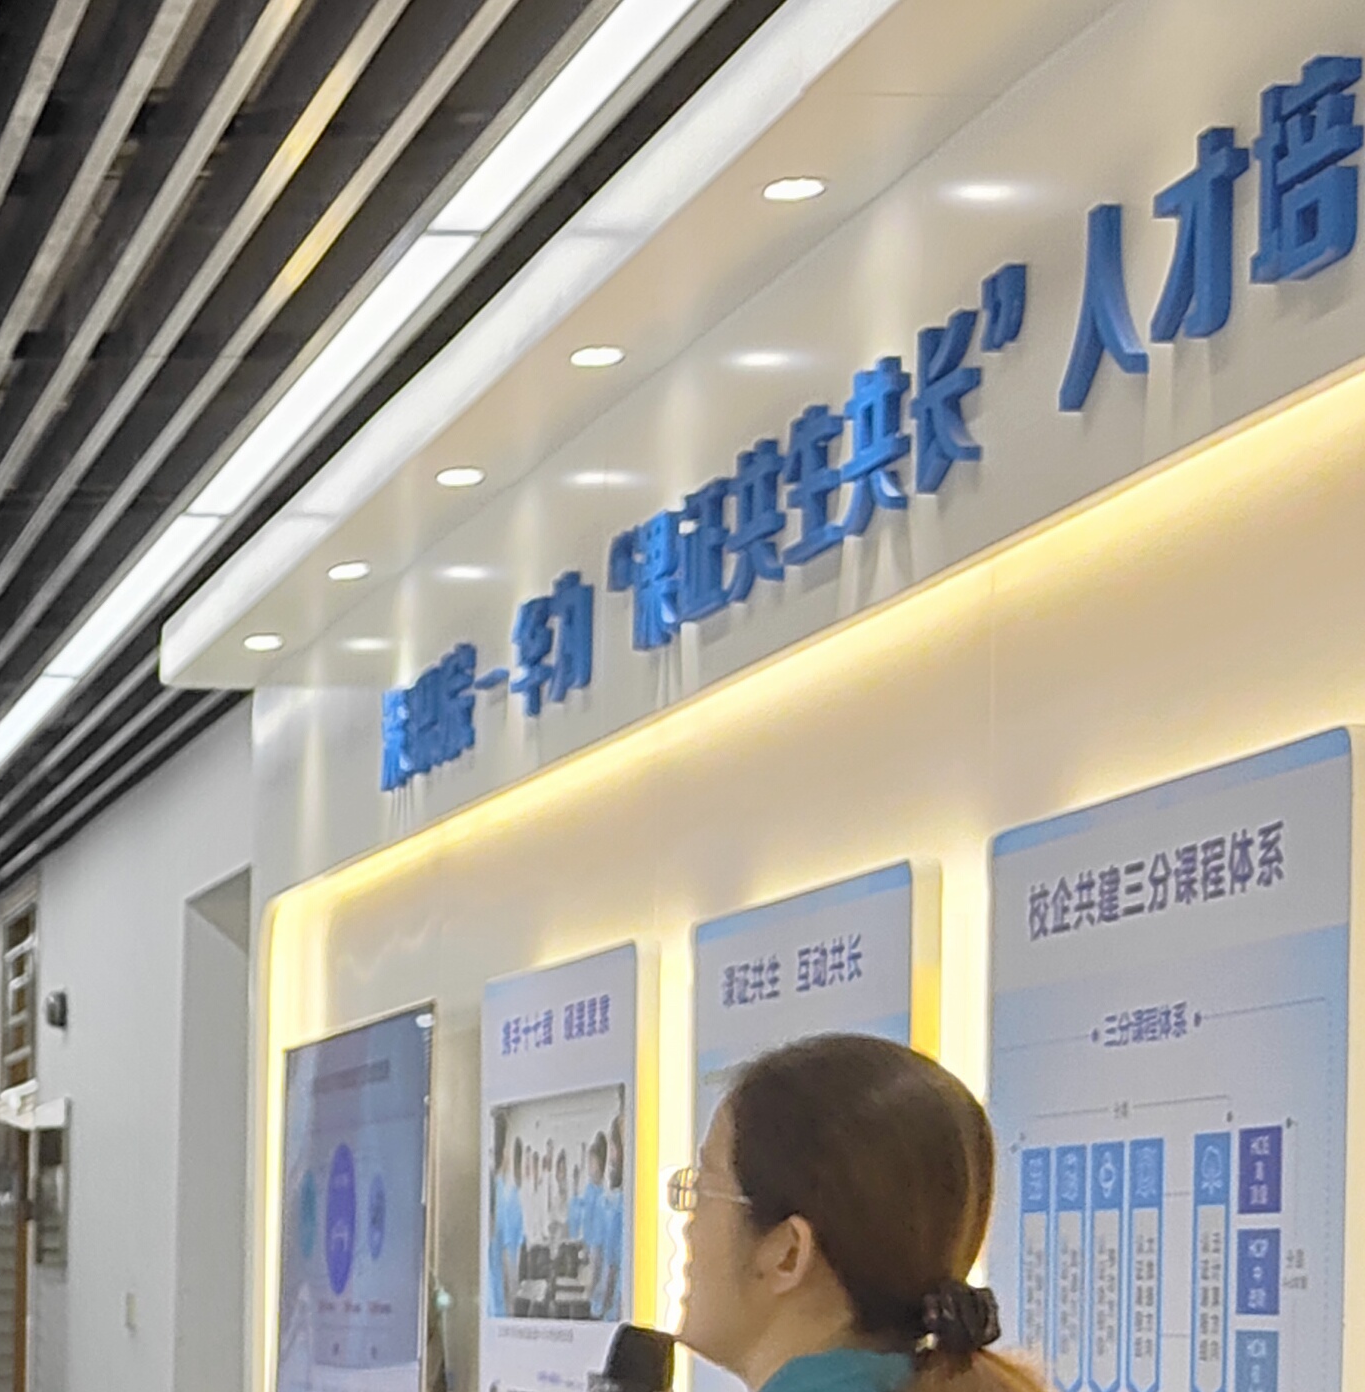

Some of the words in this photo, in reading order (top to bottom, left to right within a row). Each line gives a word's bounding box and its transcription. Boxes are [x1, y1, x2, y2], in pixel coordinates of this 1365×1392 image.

[1028, 820, 1285, 942] 校企共建三分课程体系
[721, 954, 782, 1008] 课证共生
[796, 933, 864, 994] 互动共长
[1103, 1001, 1188, 1048] 三分课程体系
